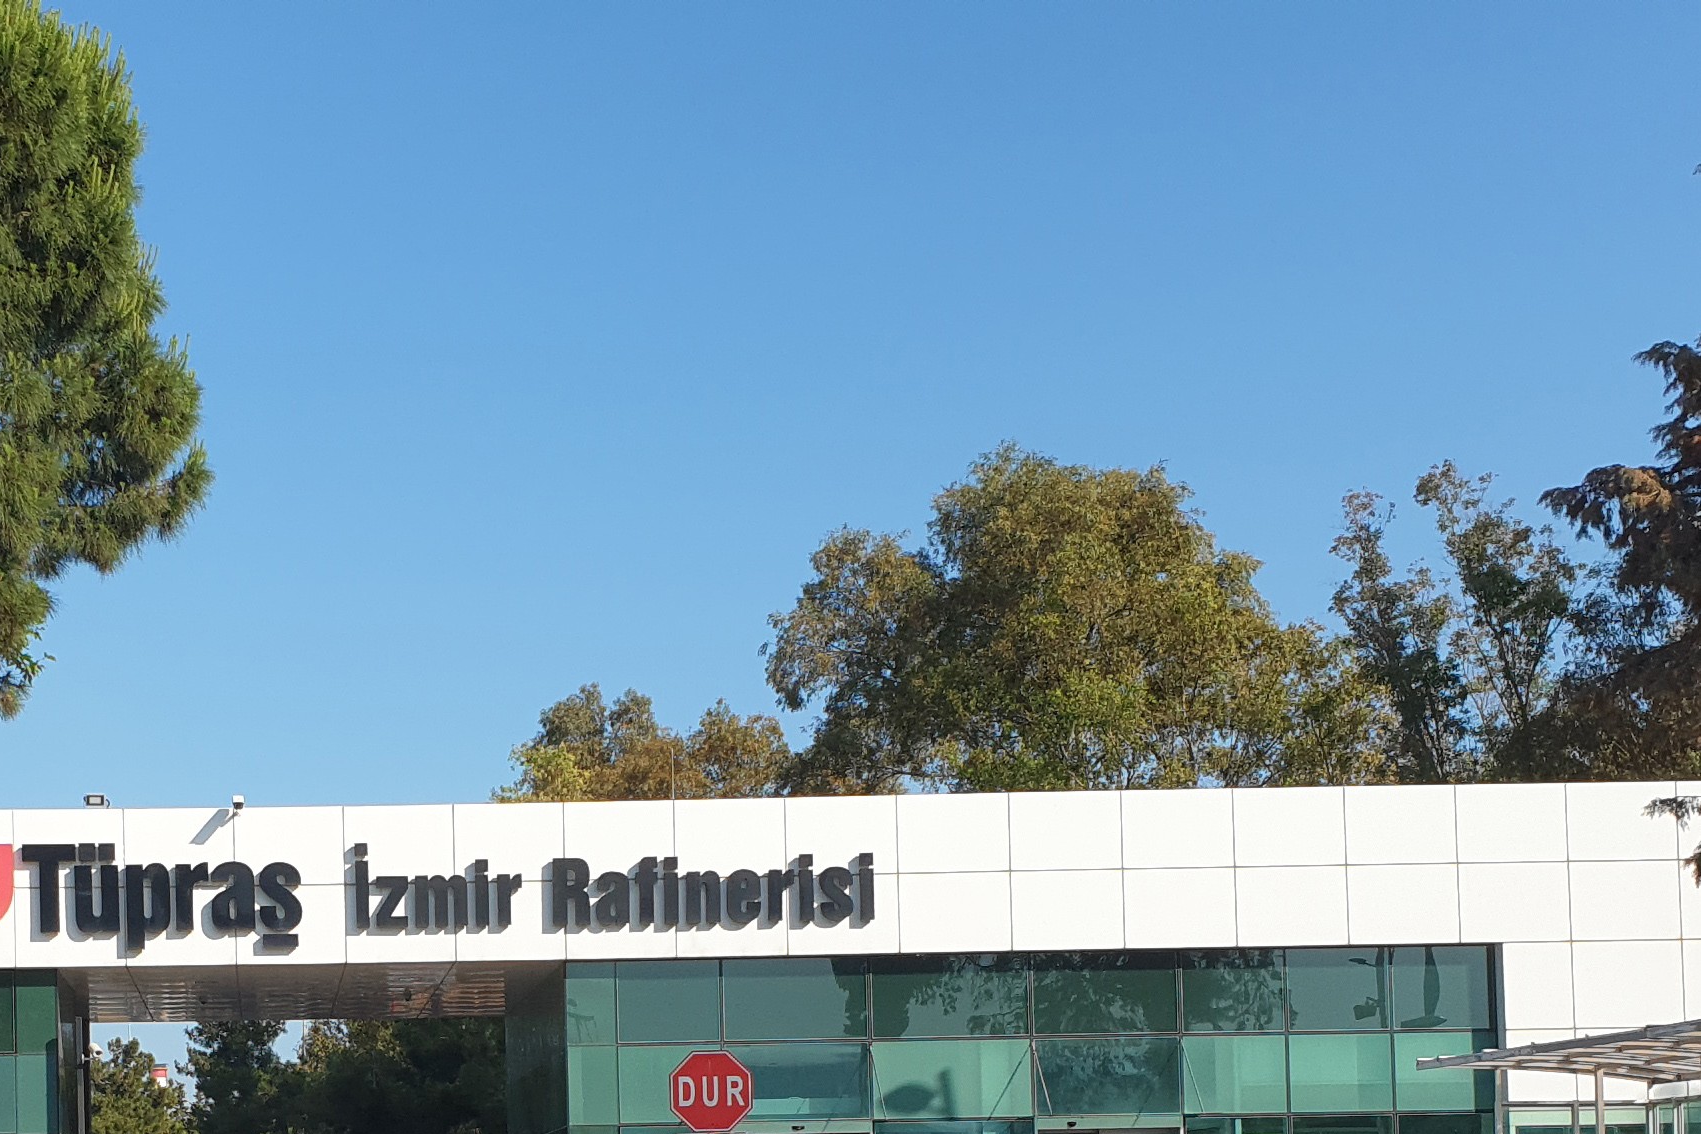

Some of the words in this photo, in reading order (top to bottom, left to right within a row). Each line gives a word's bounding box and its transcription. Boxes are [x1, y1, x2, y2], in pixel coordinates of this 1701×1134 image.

[21, 843, 303, 950] Tüpraş
[352, 843, 523, 929] İzmir
[551, 853, 876, 926] Rafinerisi
[677, 1075, 746, 1108] DUR
